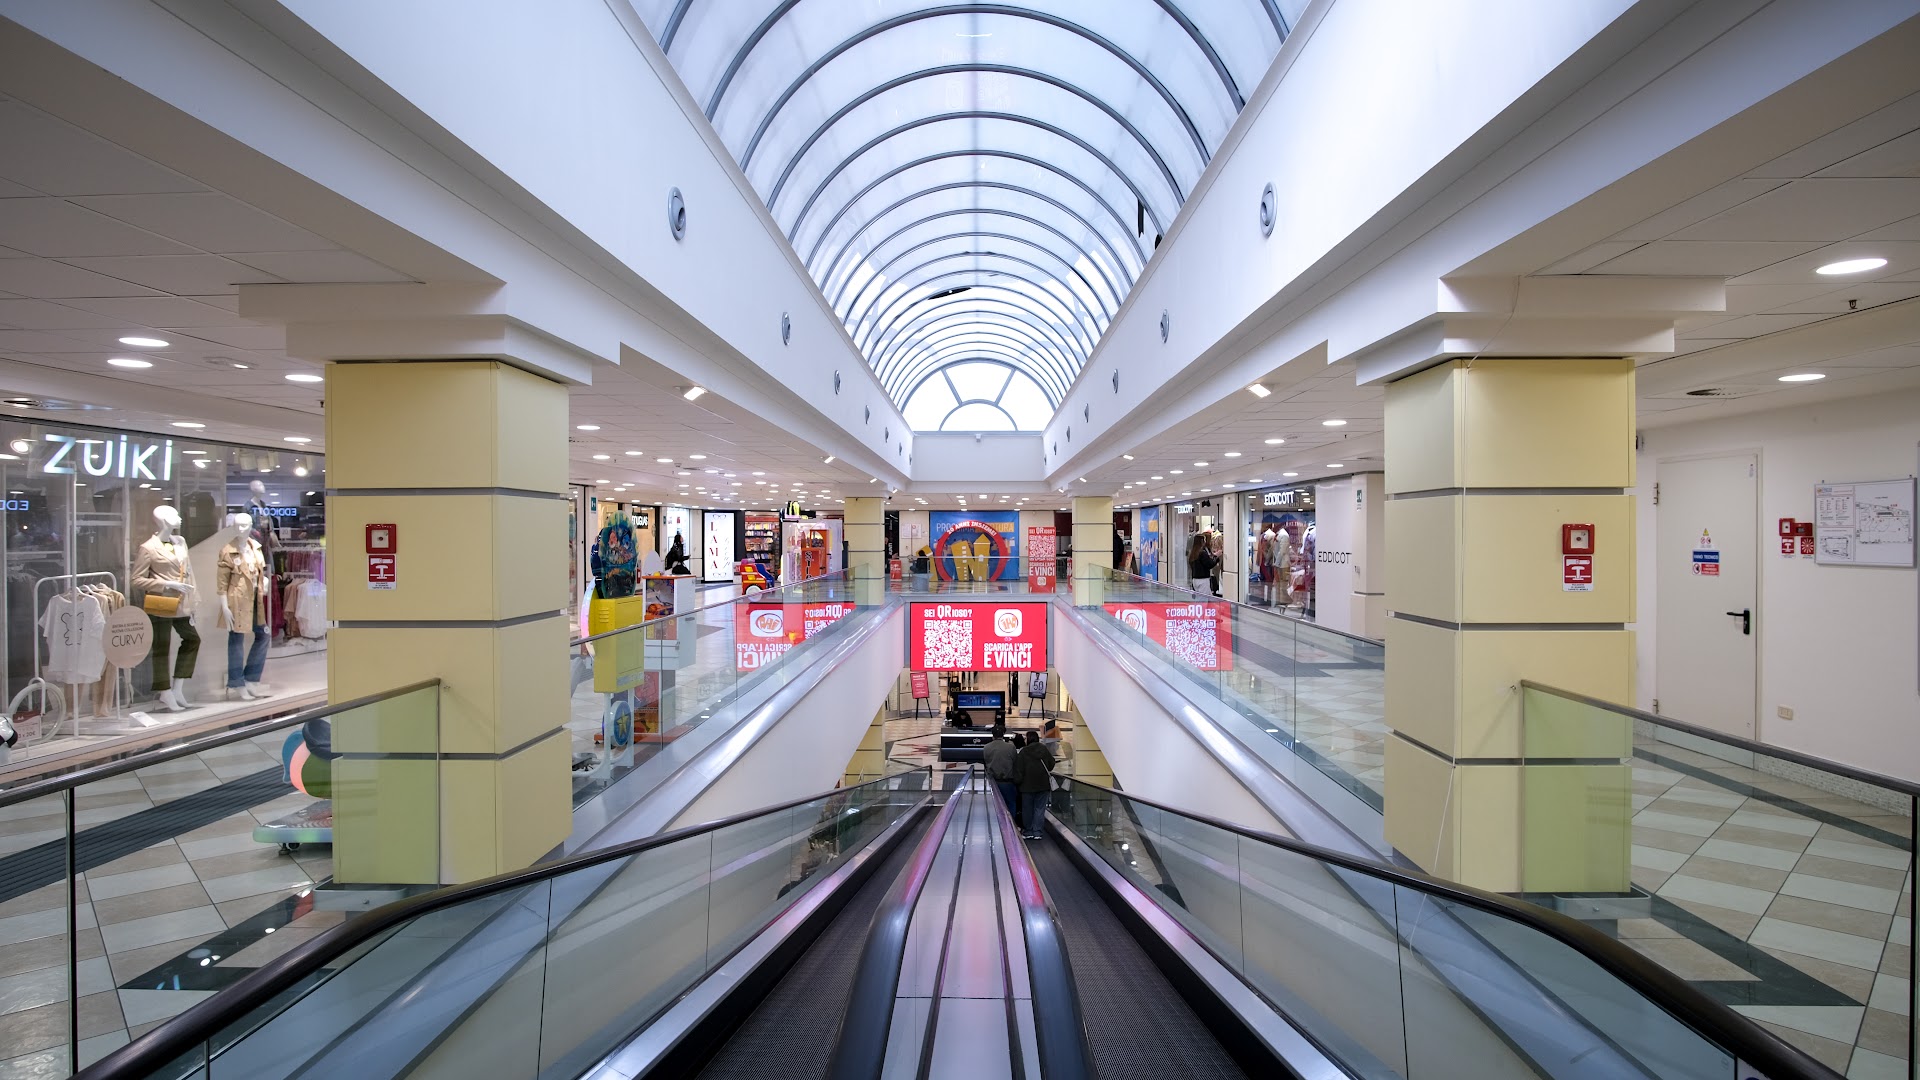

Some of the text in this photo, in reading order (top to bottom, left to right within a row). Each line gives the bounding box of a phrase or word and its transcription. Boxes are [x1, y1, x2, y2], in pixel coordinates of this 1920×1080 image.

[1035, 567, 1055, 576] VINCI
[924, 605, 972, 619] SEI QRIOSO?
[112, 633, 145, 647] CURVY
[984, 643, 1032, 651] SCARICA L'APP
[984, 652, 1031, 668] E VINCI
